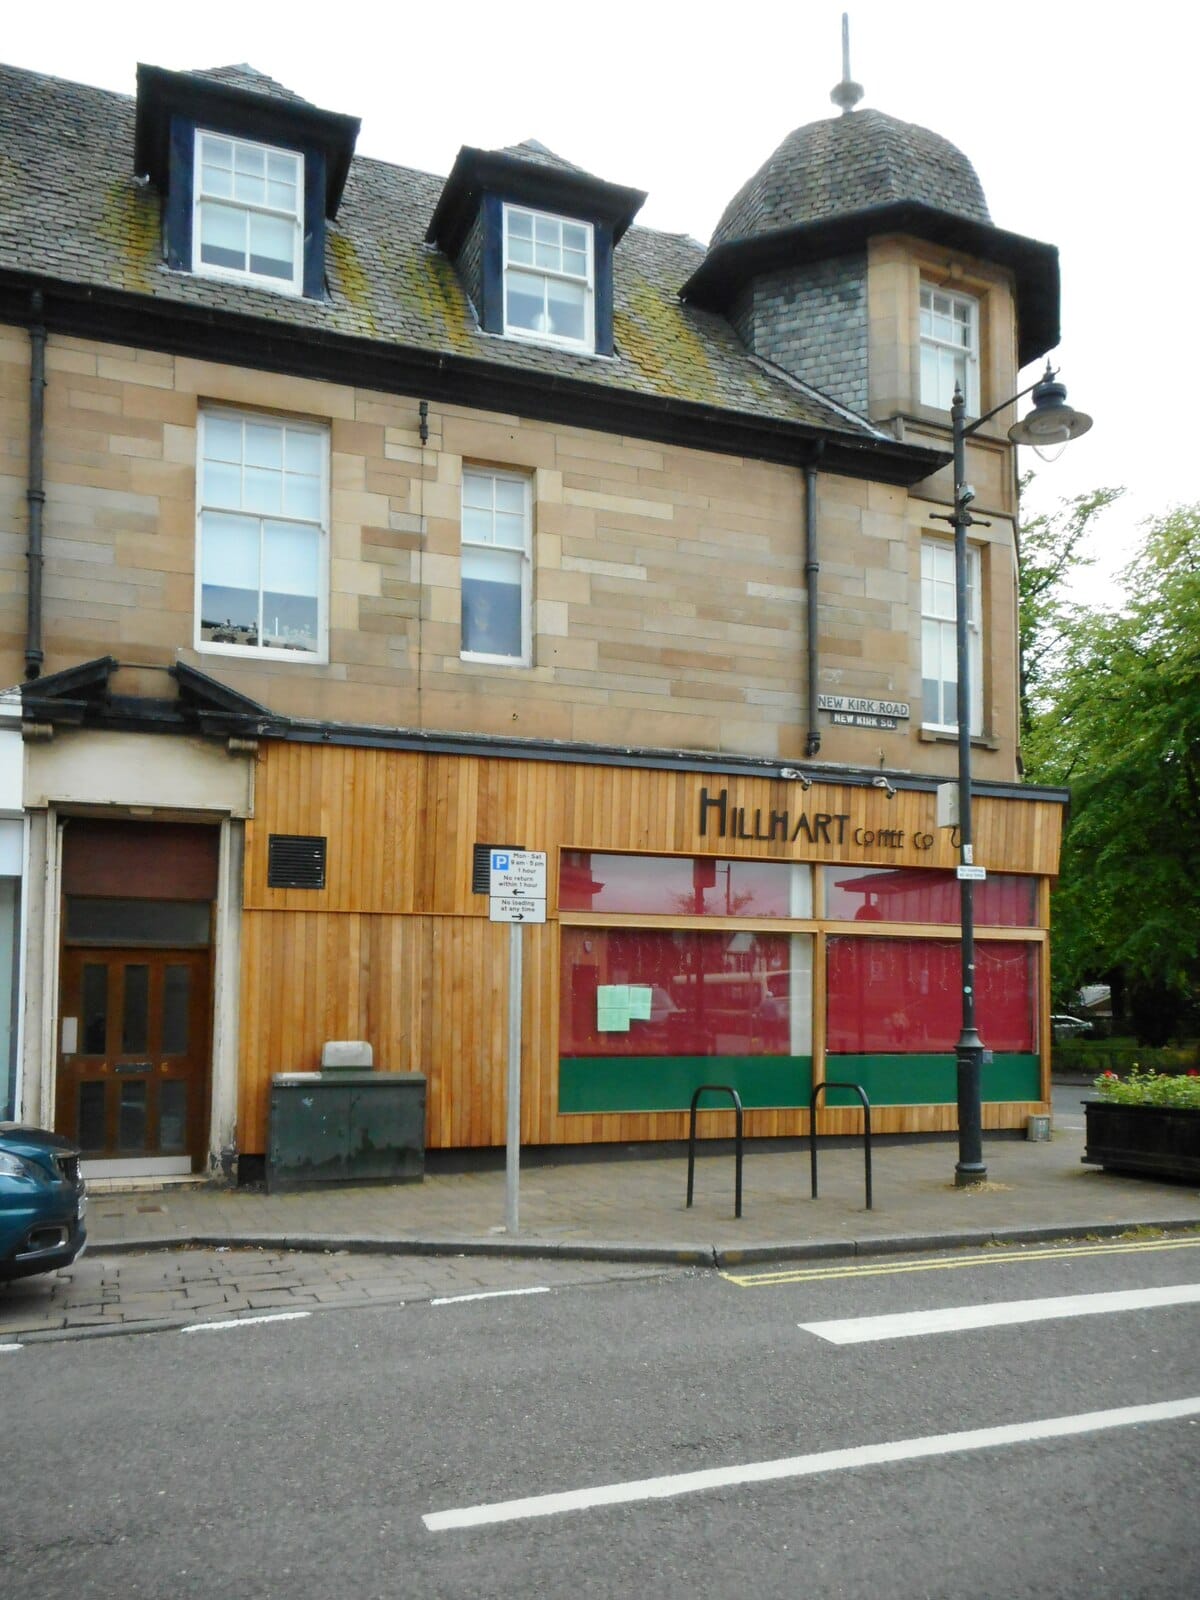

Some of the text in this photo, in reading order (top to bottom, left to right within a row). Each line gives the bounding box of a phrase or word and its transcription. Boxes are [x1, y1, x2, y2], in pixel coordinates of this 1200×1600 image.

[818, 696, 908, 716] NEW KIRK ROAD
[834, 713, 854, 723] NEW
[856, 716, 878, 726] KIRK
[699, 787, 850, 845] HILLHART
[496, 855, 507, 869] P
